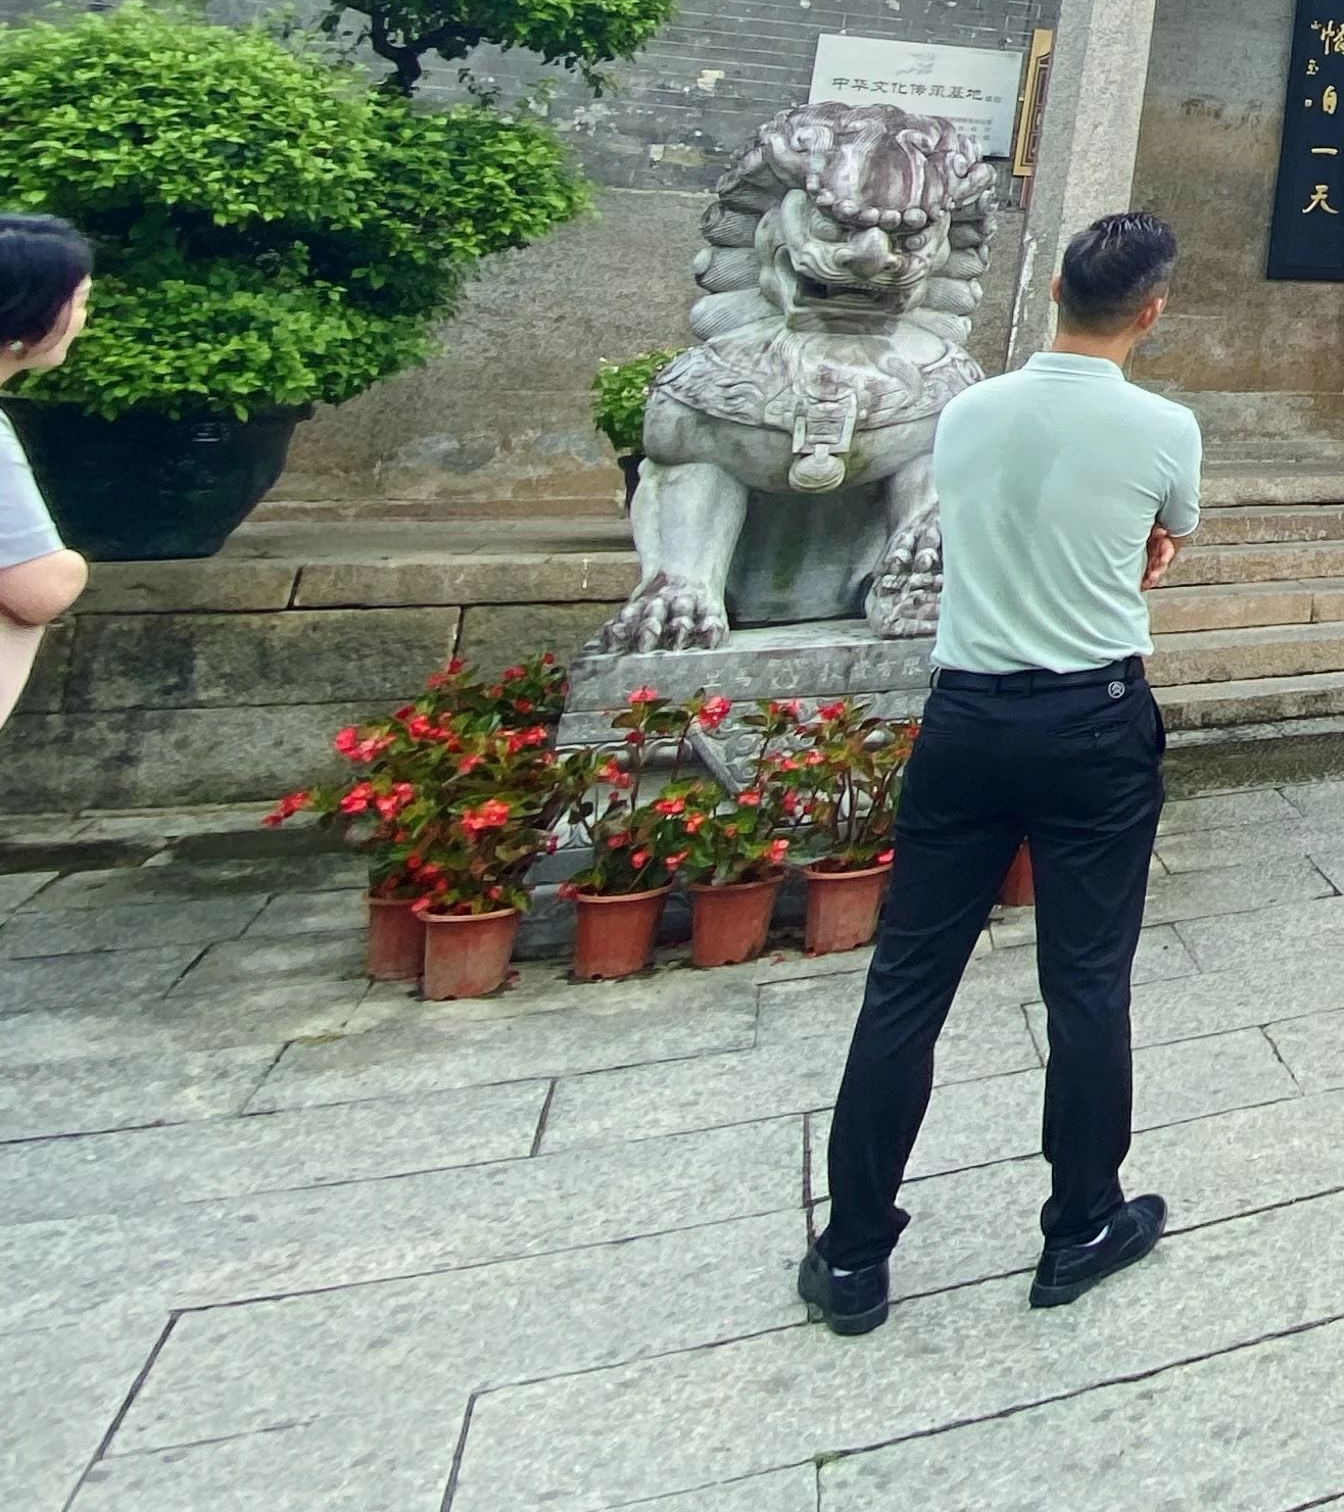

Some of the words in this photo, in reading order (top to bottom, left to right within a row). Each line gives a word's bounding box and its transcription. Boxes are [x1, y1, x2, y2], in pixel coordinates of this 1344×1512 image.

[832, 76, 984, 101] 中华文化传承基地
